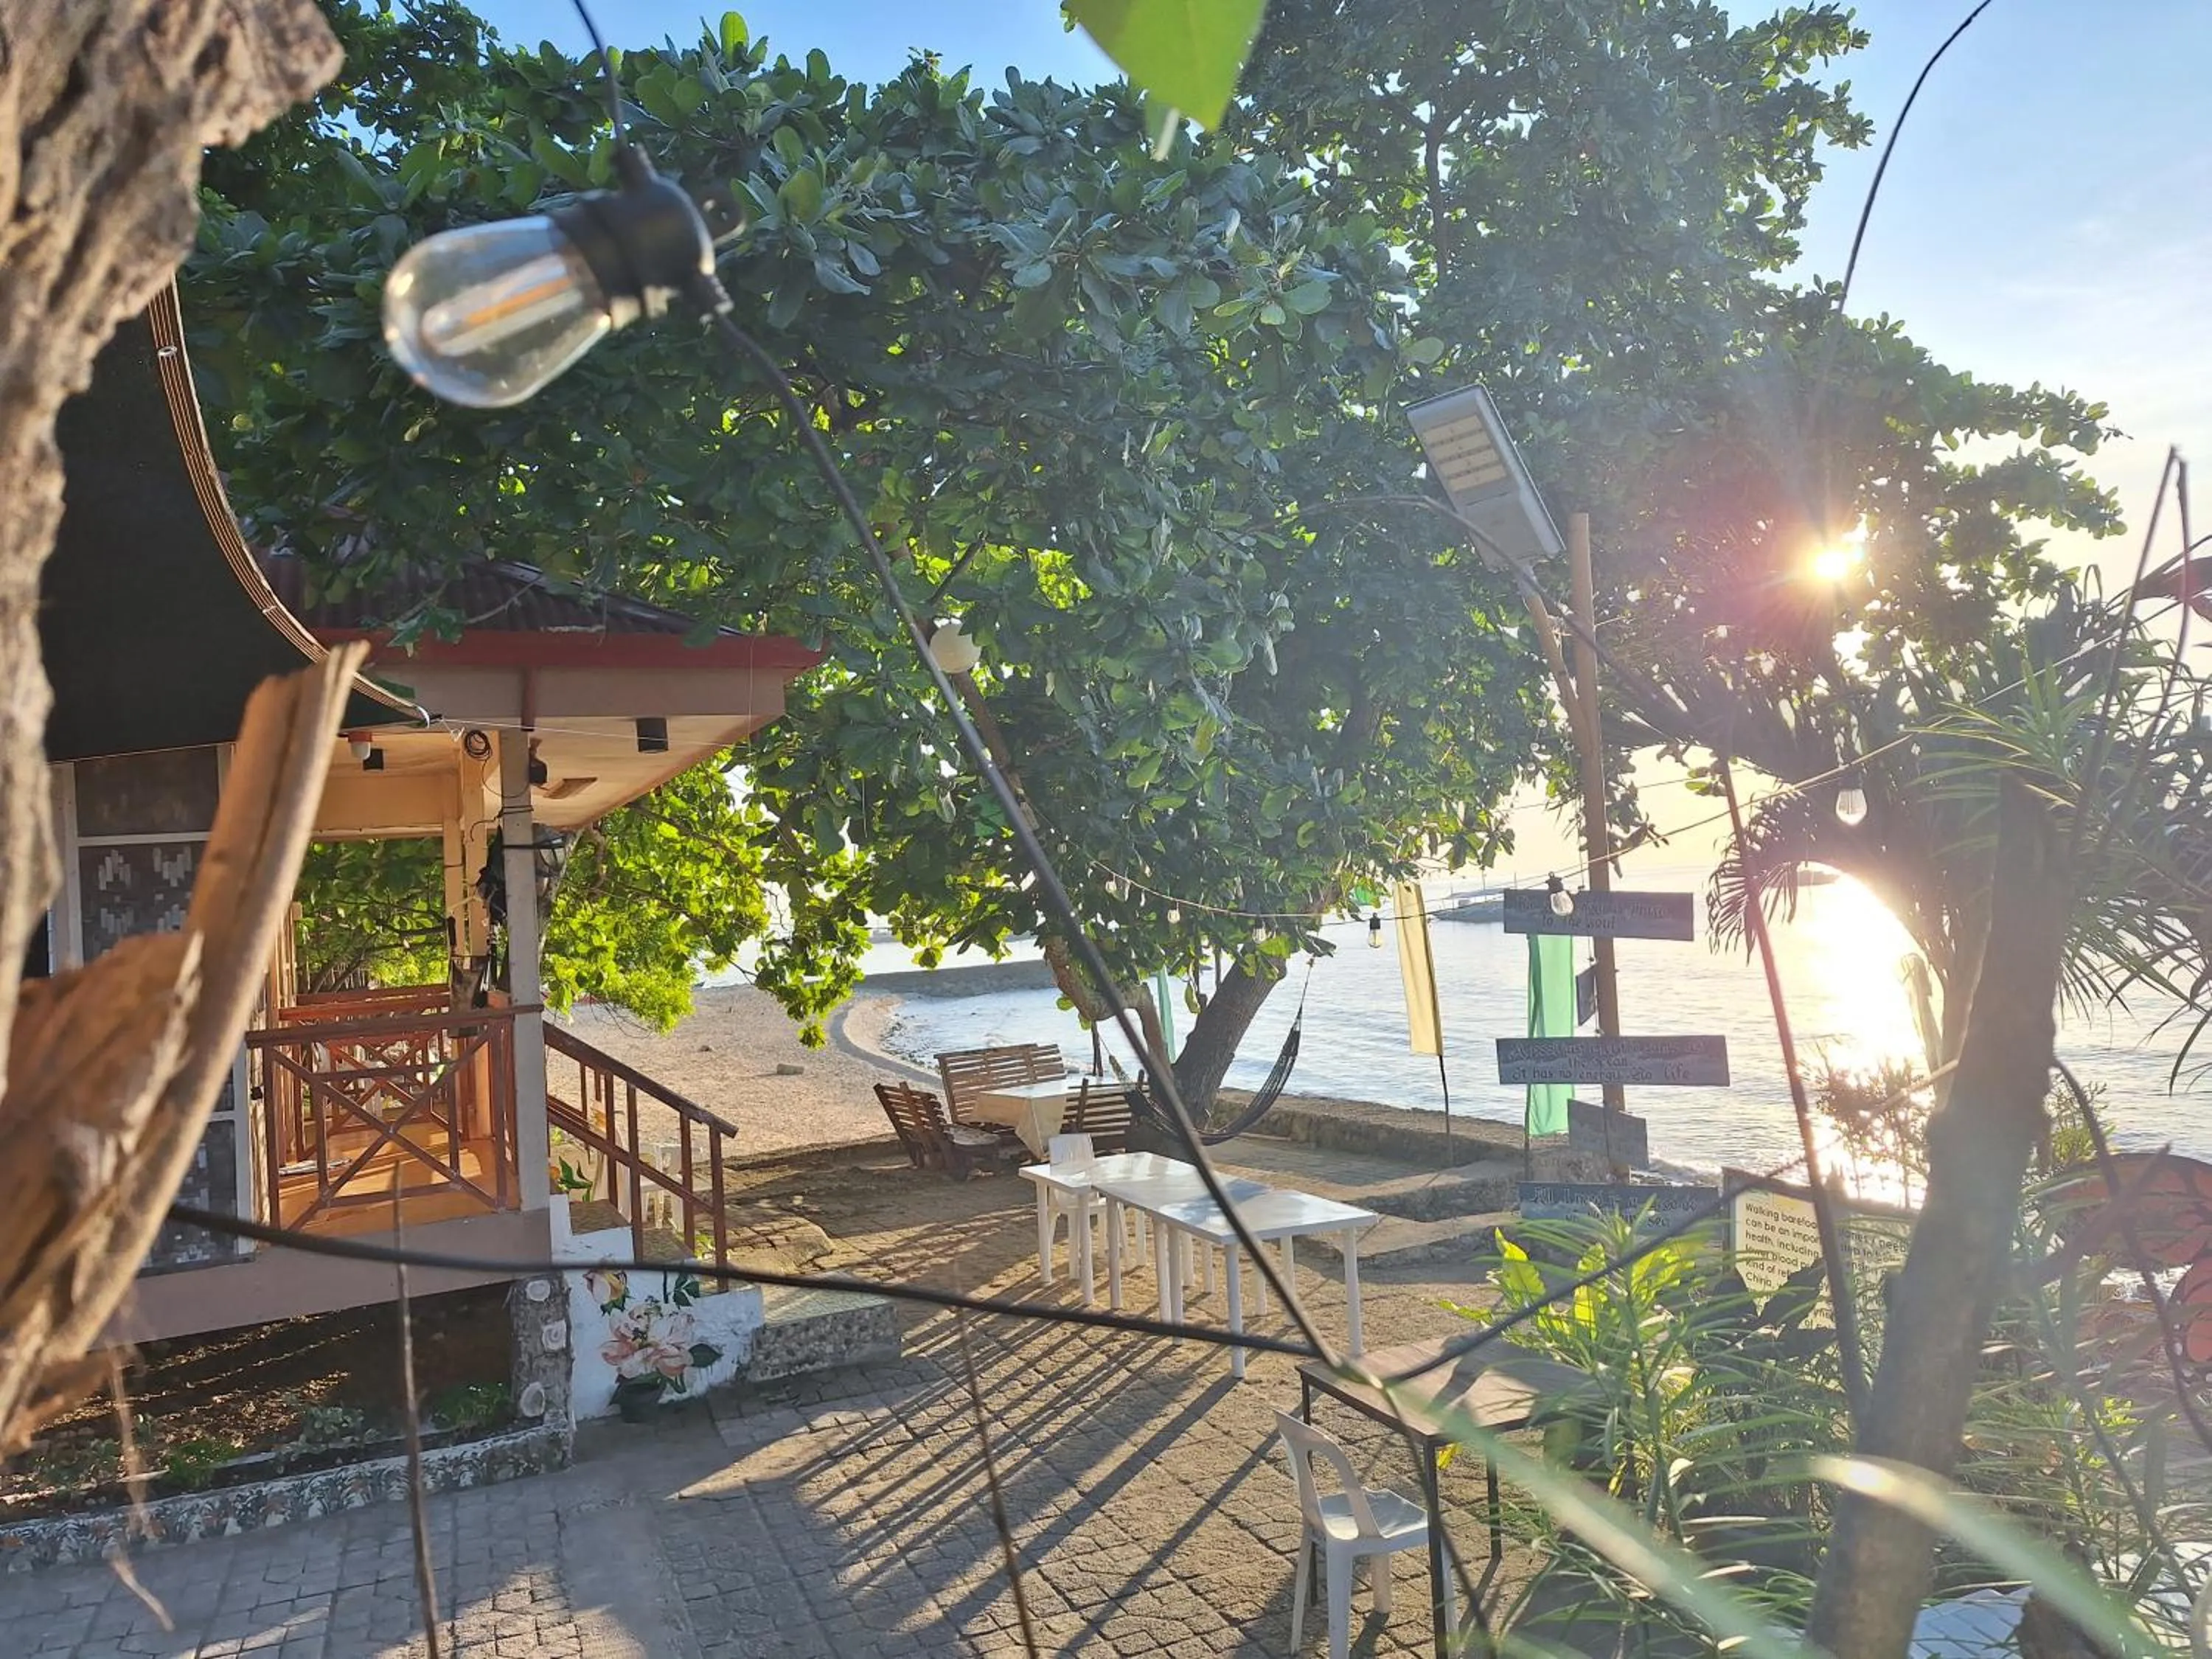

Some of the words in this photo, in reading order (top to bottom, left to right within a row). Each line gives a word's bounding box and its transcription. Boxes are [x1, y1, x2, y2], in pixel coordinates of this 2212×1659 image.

[1533, 1067, 1554, 1079] has
[1558, 1069, 1573, 1079] no
[1745, 1203, 1779, 1222] Walking
[1781, 1212, 1818, 1230] barefoo
[1745, 1218, 1763, 1228] can
[1764, 1222, 1776, 1233] be
[1778, 1227, 1790, 1237] an
[1772, 1251, 1798, 1267] blood
